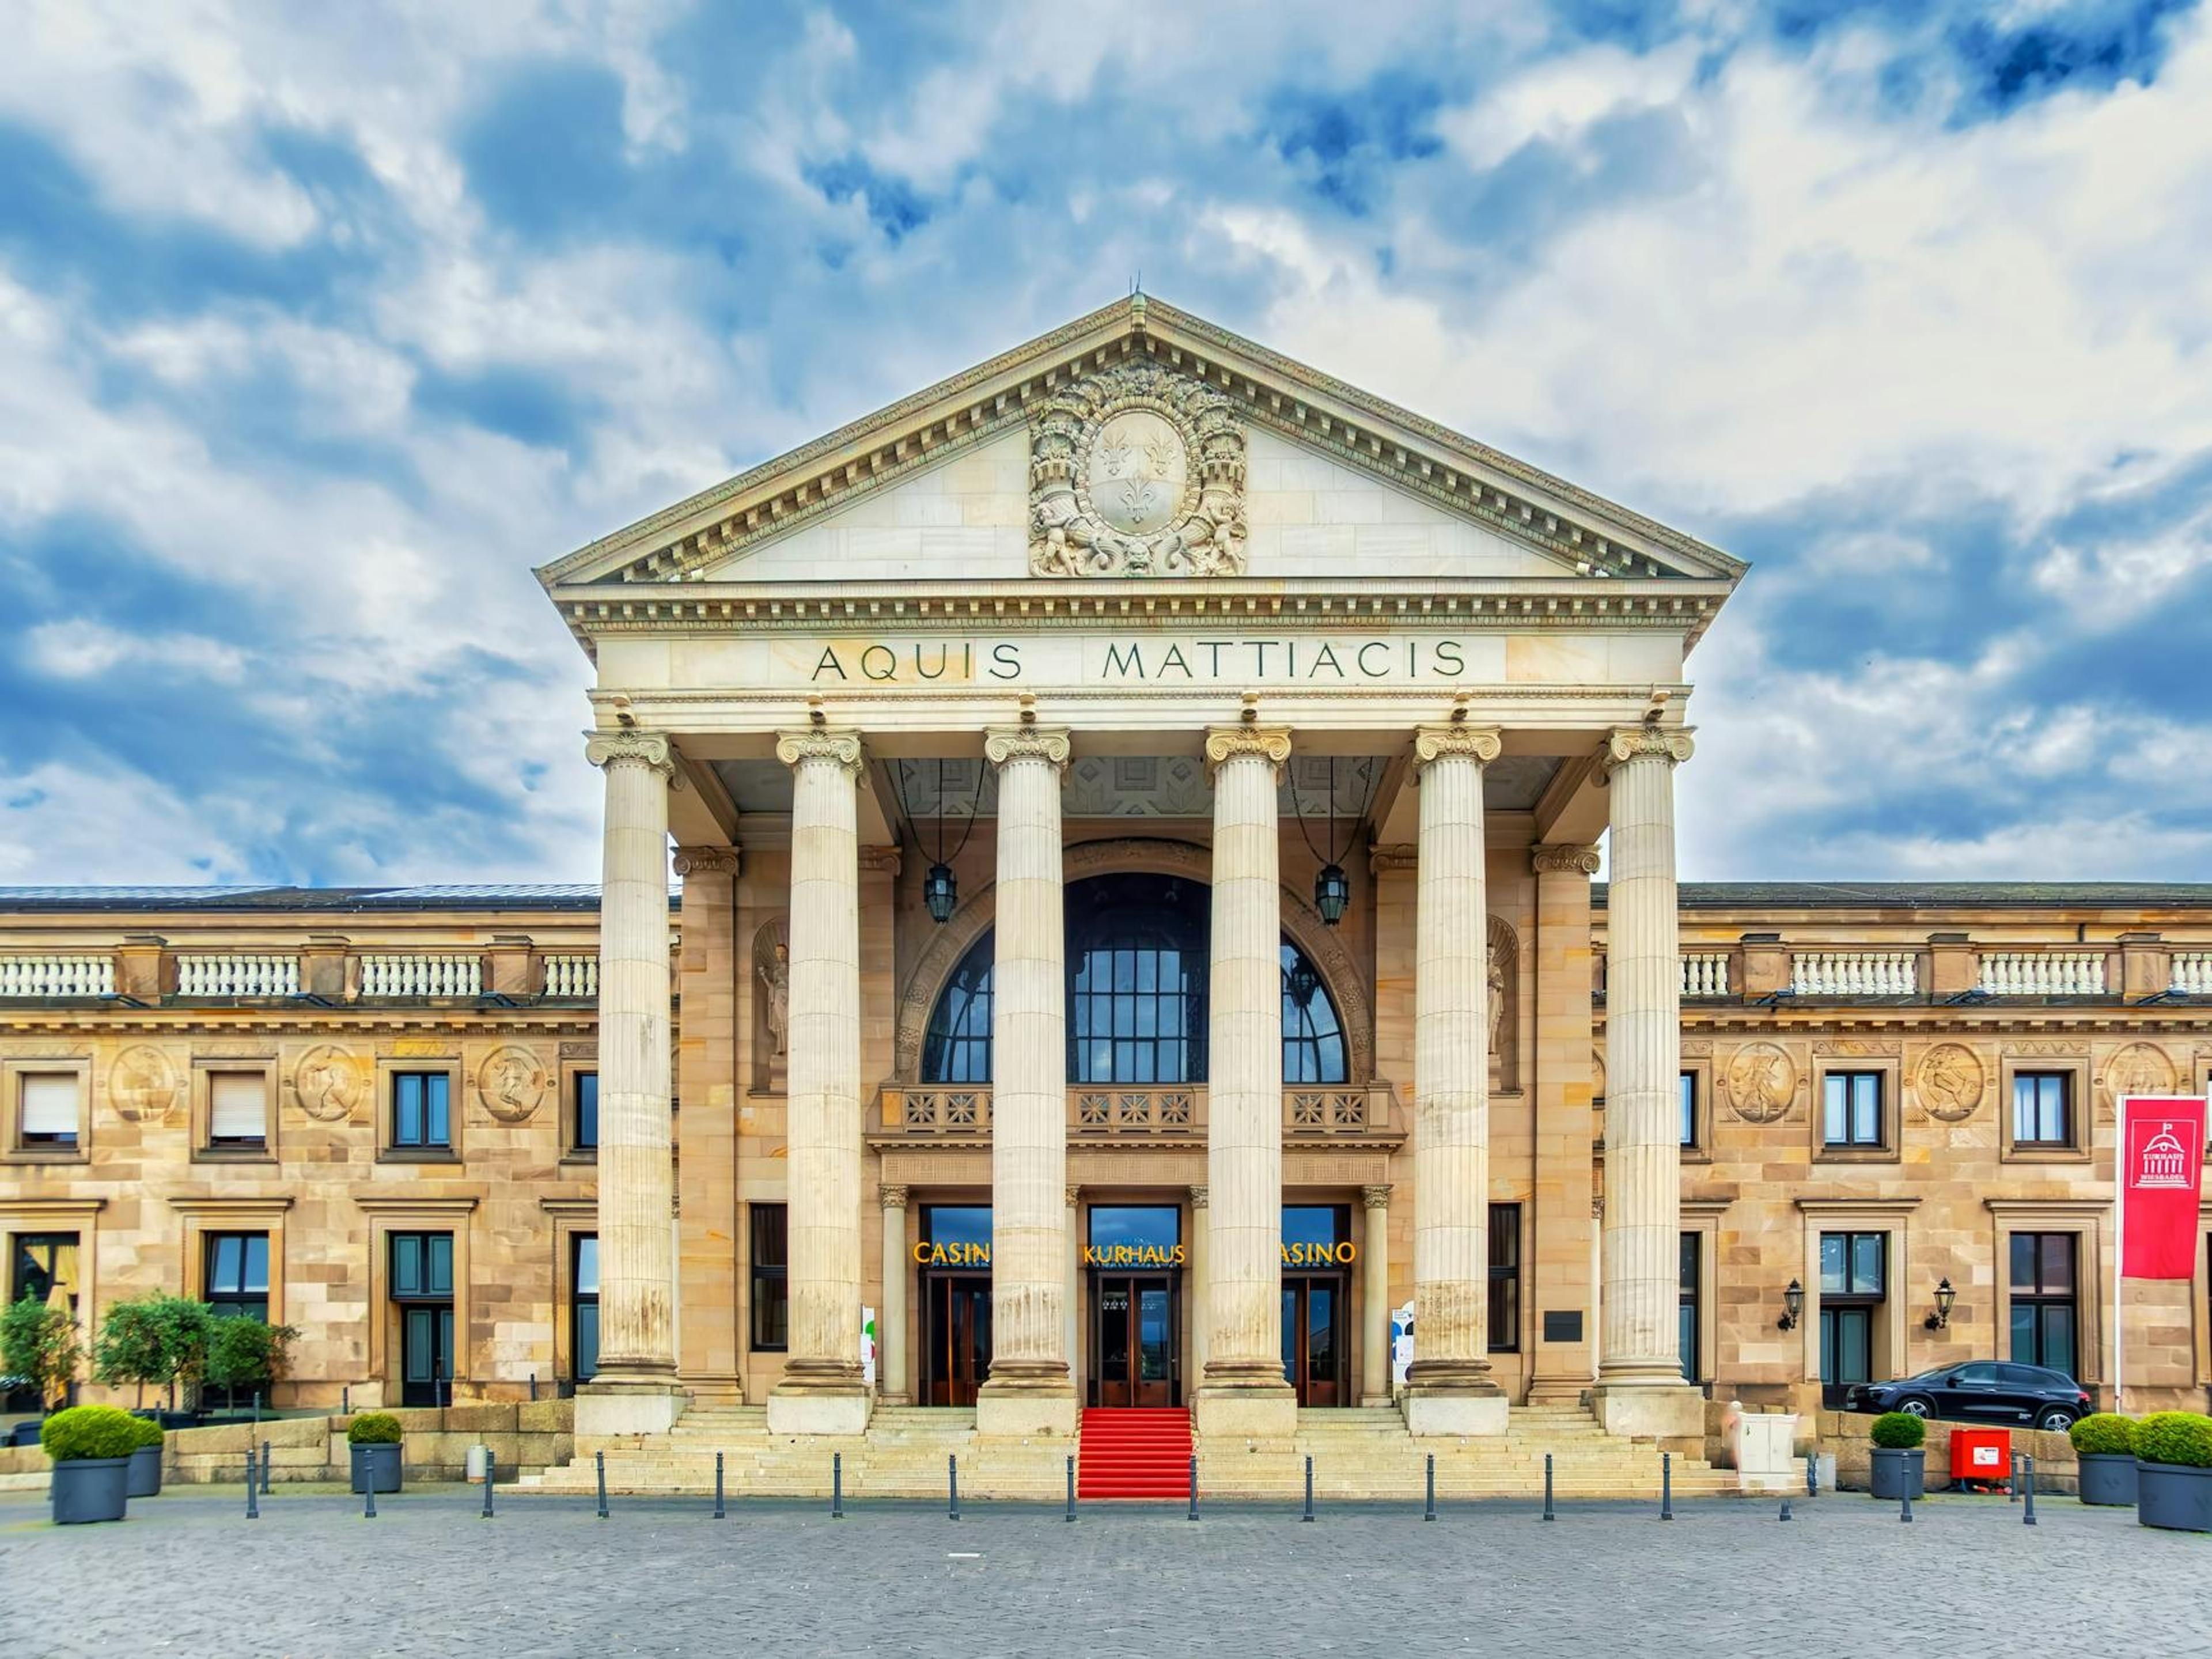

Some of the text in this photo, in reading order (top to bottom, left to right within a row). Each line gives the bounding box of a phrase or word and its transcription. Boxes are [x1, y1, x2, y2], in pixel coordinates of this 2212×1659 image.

[812, 641, 1465, 681] AQUIS MATTIACIS
[913, 1241, 990, 1263] CASIN
[1084, 1245, 1185, 1263] KURHAUS
